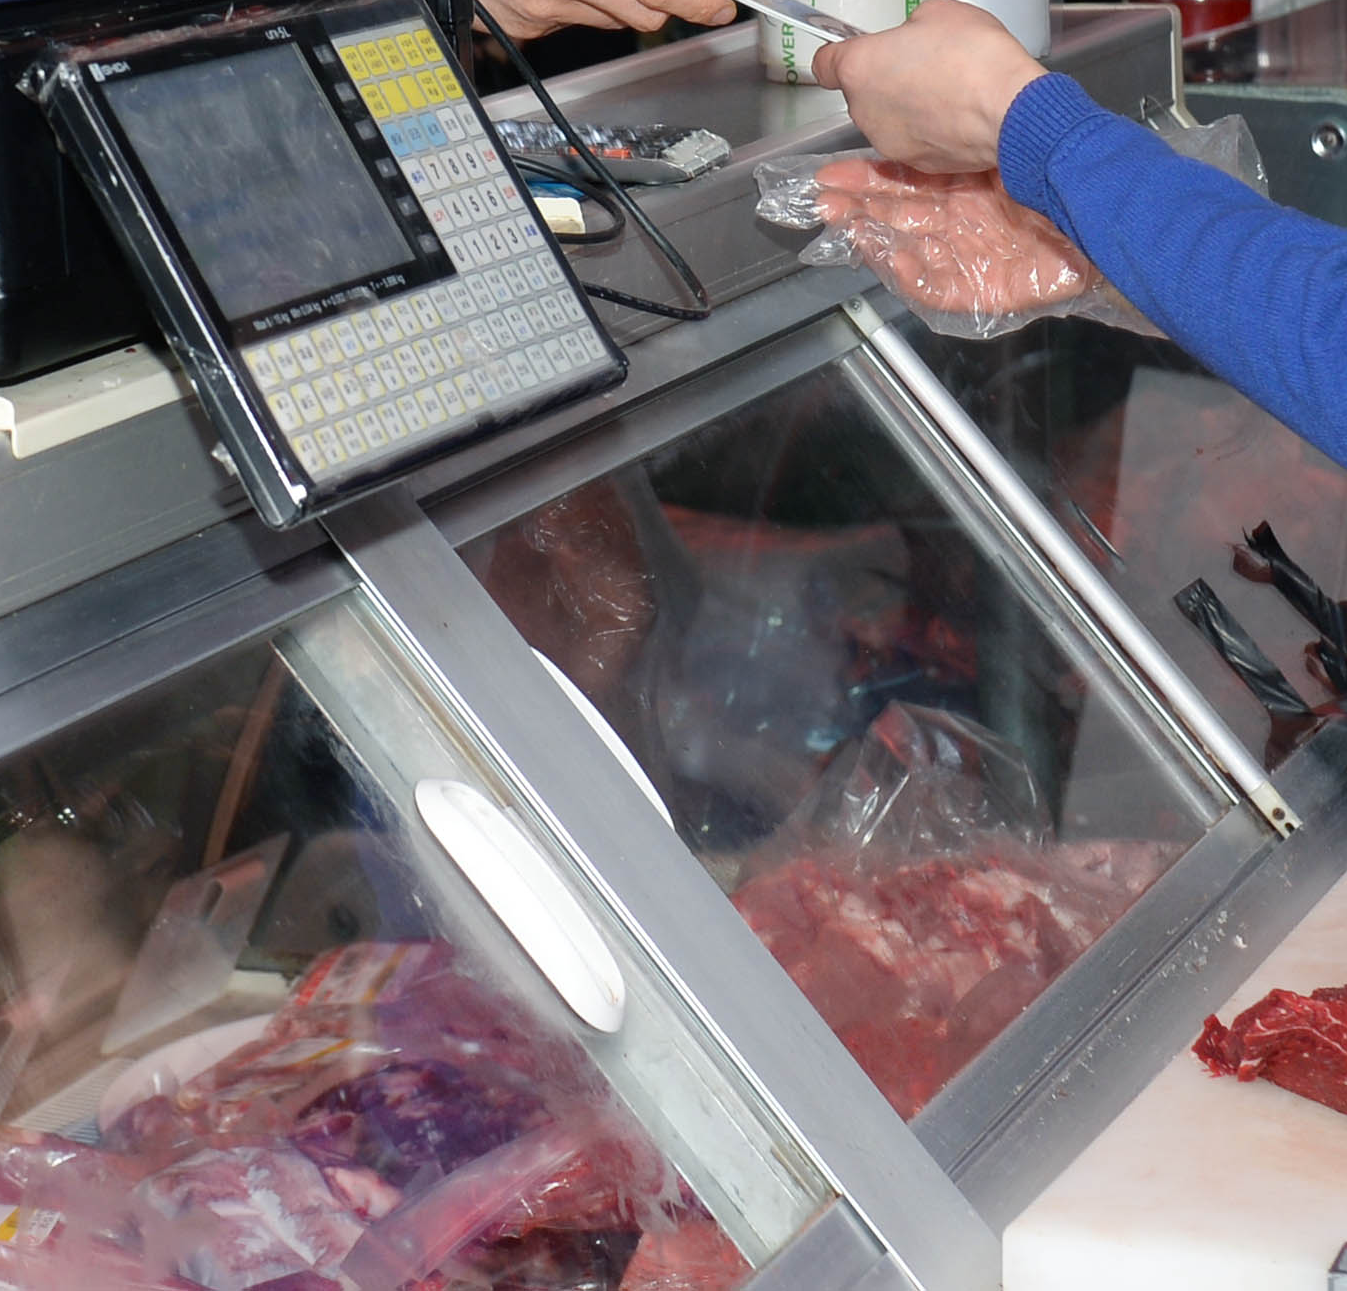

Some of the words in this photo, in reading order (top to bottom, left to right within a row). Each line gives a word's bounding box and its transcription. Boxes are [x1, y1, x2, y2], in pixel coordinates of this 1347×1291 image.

[781, 21, 798, 86] OWER
[429, 163, 441, 180] 7
[448, 158, 460, 176] 8
[466, 152, 477, 169] 9
[452, 201, 463, 217] 4
[468, 195, 480, 212] 5
[486, 190, 498, 207] 6
[453, 244, 465, 262] 0
[472, 239, 482, 256] 1
[490, 233, 501, 250] 2
[507, 227, 518, 244] 3
